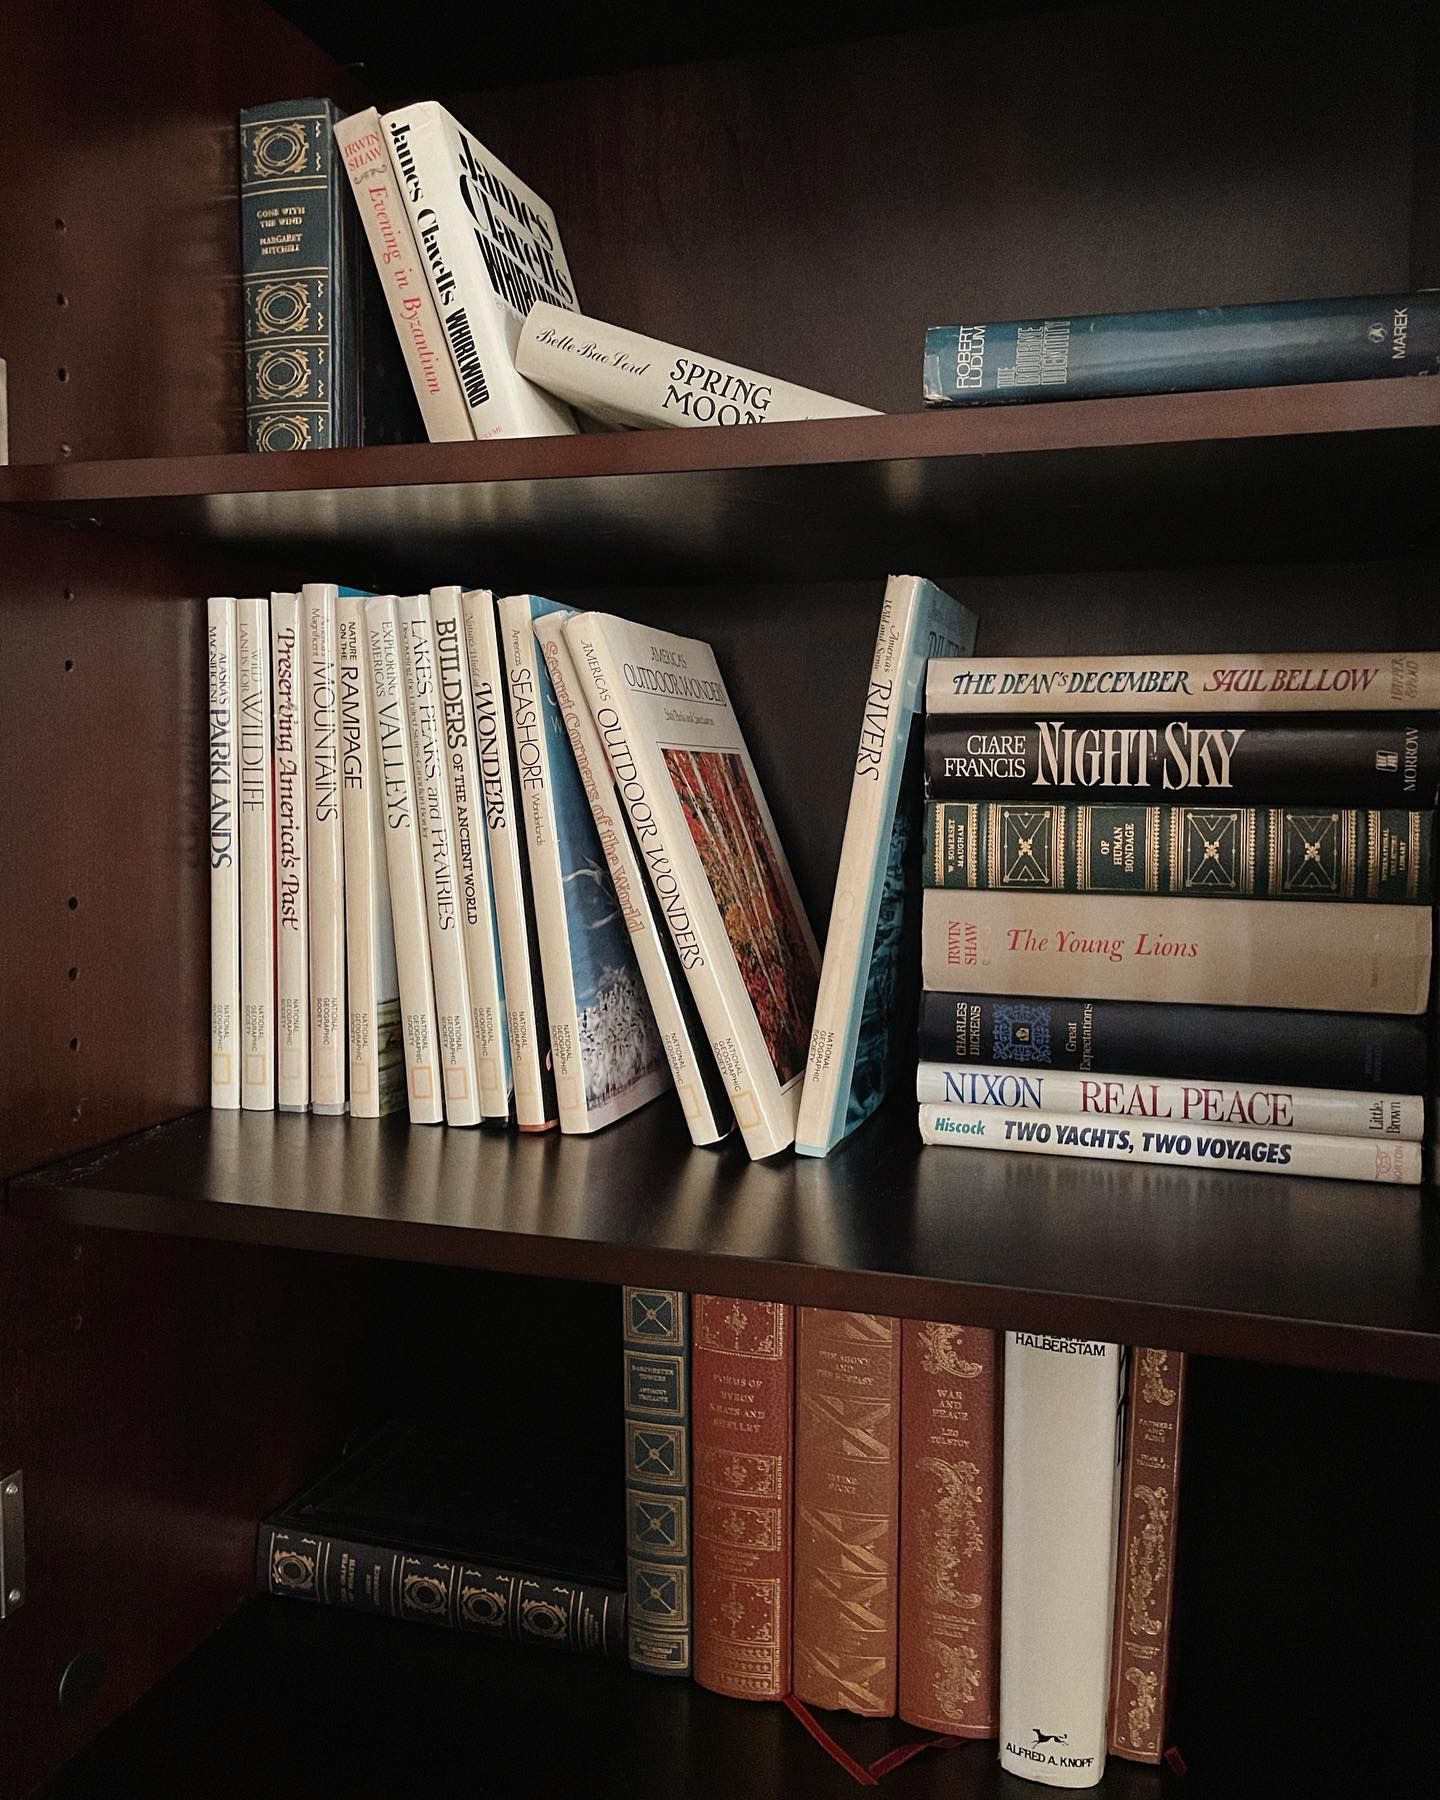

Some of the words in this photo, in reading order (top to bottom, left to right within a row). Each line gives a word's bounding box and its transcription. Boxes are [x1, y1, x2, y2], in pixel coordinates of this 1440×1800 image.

[344, 131, 381, 158] IRWIN
[348, 147, 383, 171] SHAW
[257, 208, 279, 219] GONE
[281, 206, 306, 216] WITH
[458, 130, 554, 252] James
[260, 219, 277, 229] THE
[278, 216, 303, 226] WIND
[260, 233, 303, 246] MARGARET
[368, 185, 402, 265] Evening
[261, 244, 300, 256] MITCHELL
[391, 122, 425, 203] James
[417, 208, 455, 306] Clavell's
[445, 307, 490, 409] WHIRLWIND
[393, 267, 410, 290] in
[400, 296, 442, 395] Byzantium
[956, 326, 974, 389] ROBERT
[970, 325, 988, 388] LUDLUM
[1392, 308, 1409, 359] MAREK
[669, 358, 773, 412] SPRING
[240, 623, 249, 666] LANDS
[311, 608, 321, 656] Magnificent
[340, 623, 349, 640] ON
[341, 641, 349, 661] THE
[348, 621, 358, 660] NATURE
[382, 621, 398, 696] EXPLORING
[411, 620, 434, 698] LAKES,
[543, 640, 576, 710] Secret
[952, 670, 998, 696] THE
[1064, 669, 1194, 696] DECEMBER
[1202, 668, 1270, 693] SAUL
[1268, 668, 1380, 693] BELLOW
[436, 618, 468, 749] BUILDERS
[241, 691, 265, 814] WILDLIFE
[313, 661, 338, 822] MOUNTAINS
[341, 667, 363, 790] RAMPAGE
[510, 668, 544, 791] SEASHORE
[855, 679, 893, 781] RIVERS
[967, 735, 1026, 755] CLARE
[378, 702, 411, 829] VALLEYS
[452, 753, 464, 773] OF
[474, 681, 506, 830] WONDERS
[565, 712, 600, 802] Corners
[943, 757, 1026, 779] FRANCIS
[1031, 721, 1158, 788] NIGHT
[1162, 721, 1246, 791] SKY
[1403, 727, 1420, 792] MORROW
[210, 709, 233, 869] PARKLANDS
[280, 757, 302, 869] America's
[427, 787, 443, 820] and
[455, 776, 467, 803] THE
[457, 806, 473, 872] ANCIENT
[593, 803, 614, 827] of
[598, 707, 658, 844] OUTDOOR
[645, 844, 705, 970] WONDERS
[600, 828, 620, 866] the
[957, 824, 966, 868] MAUGHAM
[1099, 839, 1111, 855] OF
[1112, 826, 1124, 867] HUMAN
[1123, 823, 1135, 873] BONDAGE
[281, 873, 300, 931] Past
[431, 829, 456, 931] PRAIRIES
[464, 874, 478, 926] WORLD
[612, 865, 646, 933] World
[948, 920, 962, 966] IRWIN
[964, 922, 978, 967] SHAW
[1006, 928, 1049, 953] The
[1055, 929, 1125, 963] Young
[1133, 932, 1199, 958] Lions
[413, 1014, 422, 1064] GEOGRAPHIC
[420, 1014, 428, 1050] NATIONAL
[447, 1016, 456, 1065] GEOGRAPHIC
[454, 1015, 462, 1052] NATIONAL
[478, 1008, 488, 1057] GEOGRAPHIC
[485, 1007, 494, 1043] NATIONAL
[512, 1011, 521, 1062] GEOGRAPHIC
[519, 1011, 528, 1048] NATIONAL
[563, 1024, 573, 1061] NATIONAL
[809, 1029, 820, 1063] SOCIETY
[955, 1001, 968, 1057] CHARLES
[969, 1004, 982, 1057] DICKENS
[1064, 1022, 1078, 1053] Great
[1079, 1003, 1094, 1072] Expectations
[557, 1025, 567, 1076] GEOGRAPHIC
[664, 1034, 683, 1085] GEOGRAPHIC
[671, 1032, 686, 1070] NATIONAL
[712, 1042, 728, 1077] SOCIETY
[718, 1040, 741, 1092] GEOGRAPHIC
[725, 1037, 742, 1076] NATIONAL
[812, 1030, 827, 1083] GEOGRAPHIC
[823, 1031, 835, 1070] NATIONAL
[942, 1071, 1044, 1110] NIXON
[1079, 1080, 1173, 1119] REAL
[1180, 1086, 1294, 1128] PEACE
[1368, 1100, 1384, 1131] Little,
[1386, 1101, 1402, 1136] Brown
[934, 1117, 986, 1136] Hiscock
[1004, 1120, 1052, 1144] TWO
[1055, 1124, 1135, 1154] YACHTS,
[1142, 1131, 1192, 1156] TWO
[1195, 1136, 1292, 1165] VOYAGES
[1015, 1332, 1106, 1357] HALBERSTAM
[743, 1410, 766, 1420] AND
[931, 1408, 969, 1421] PEACE
[937, 1388, 963, 1401] WAR
[938, 1400, 963, 1411] AND
[1005, 1742, 1047, 1763] ALFRED
[1047, 1755, 1059, 1767] A.
[1060, 1756, 1095, 1769] KNOPF
